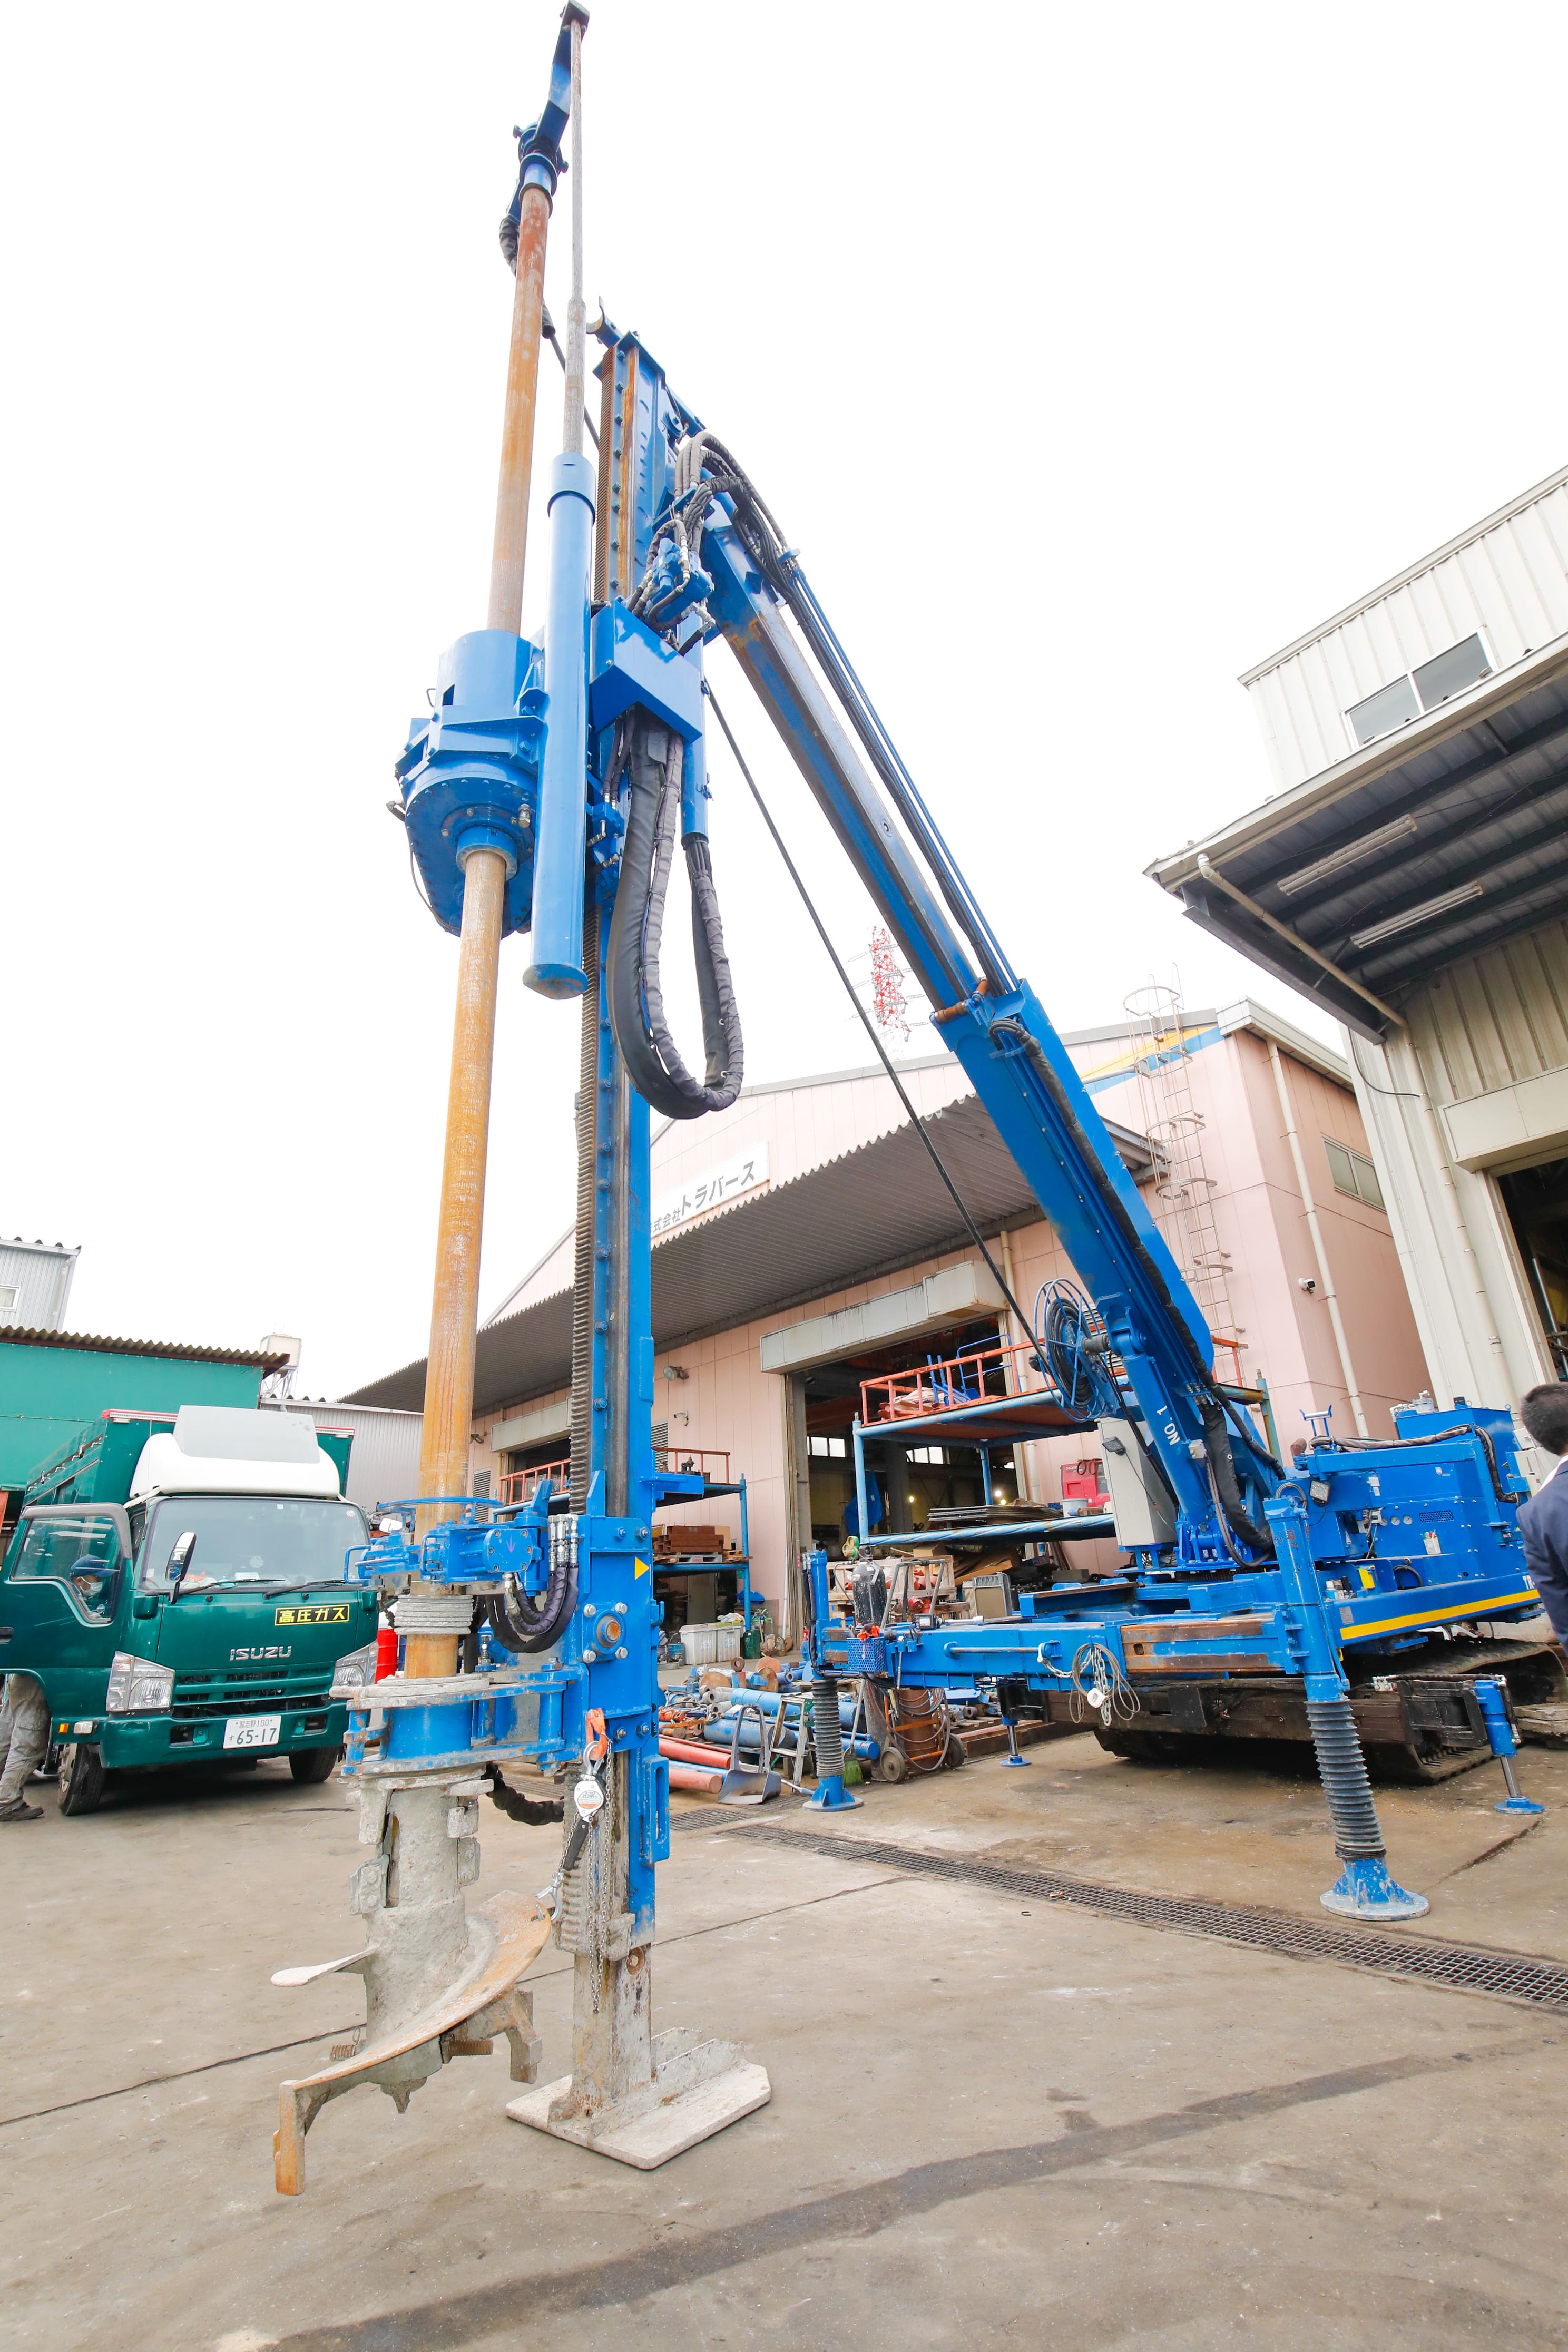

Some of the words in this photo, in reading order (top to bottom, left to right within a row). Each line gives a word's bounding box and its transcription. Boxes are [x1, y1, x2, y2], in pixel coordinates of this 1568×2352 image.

[279, 1606, 346, 1623] 高圧ガス
[229, 1645, 292, 1661] ISUZU
[237, 1727, 277, 1745] 65-17
